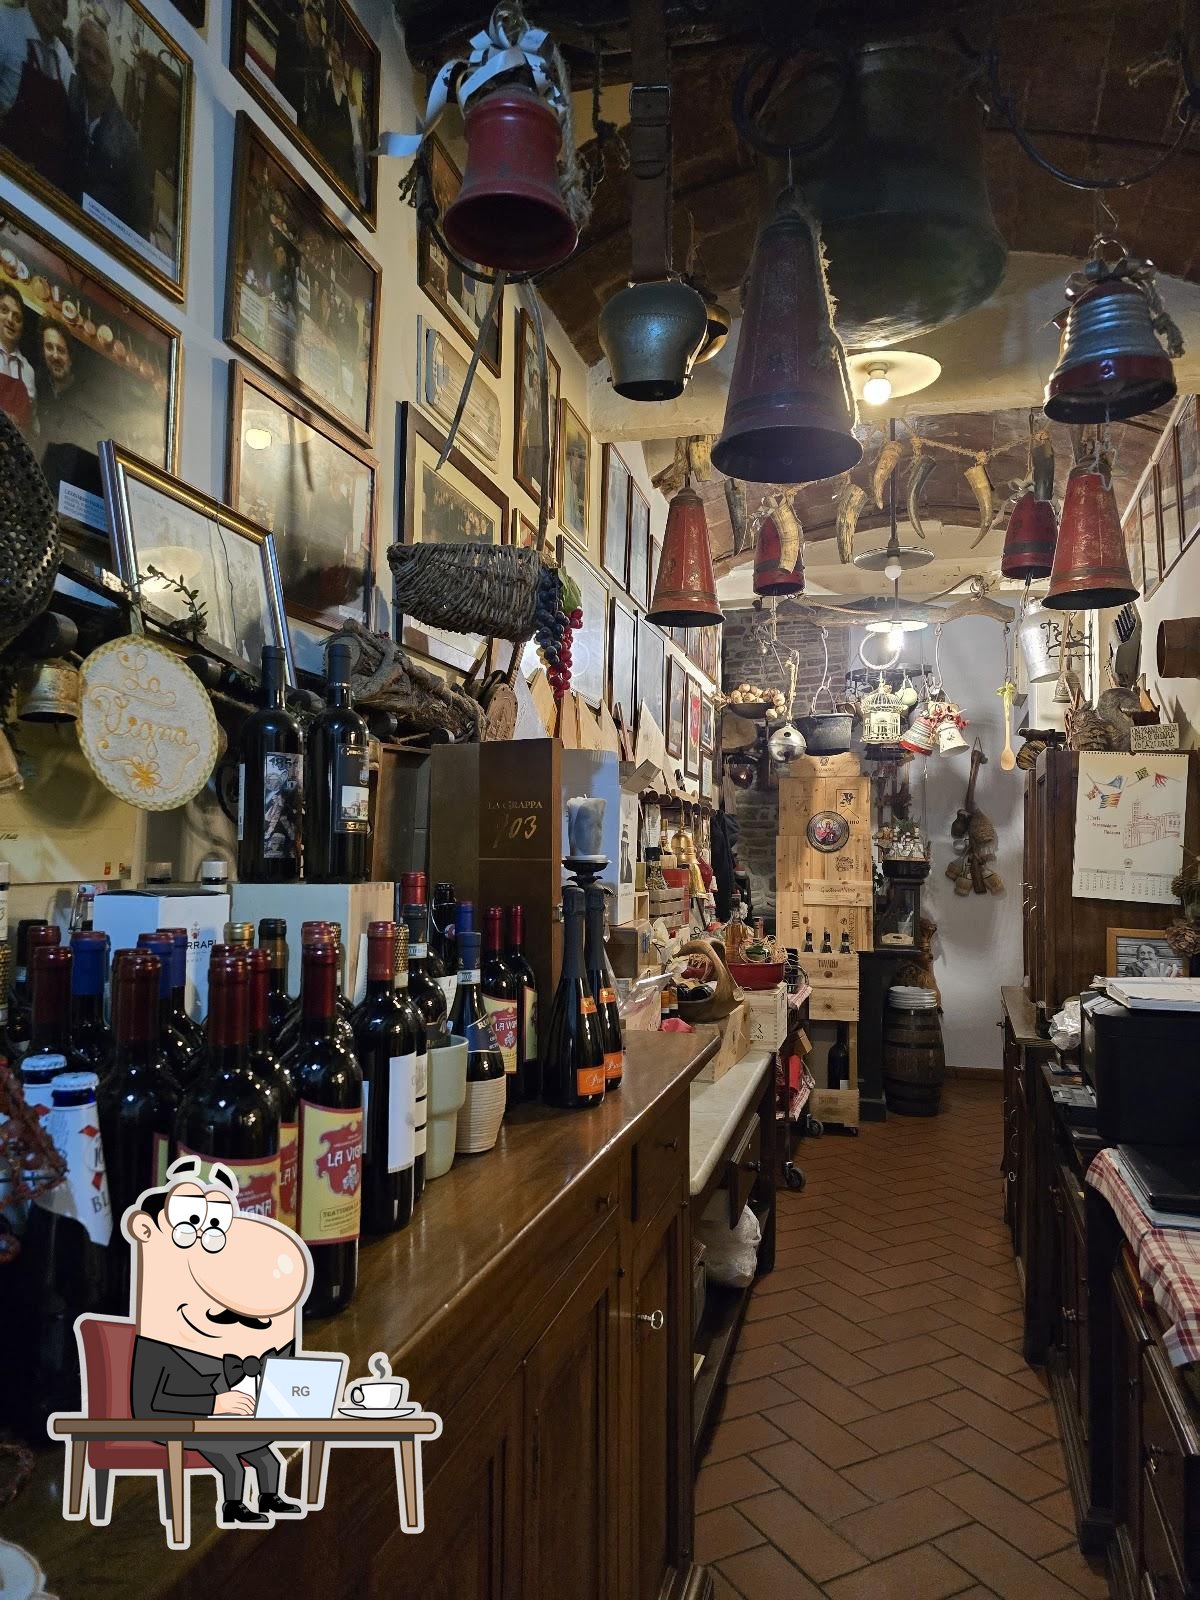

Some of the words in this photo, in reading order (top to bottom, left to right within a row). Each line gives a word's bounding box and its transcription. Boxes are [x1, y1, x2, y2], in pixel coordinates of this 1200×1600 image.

[91, 686, 197, 760] Vigna
[488, 801, 500, 809] LA
[502, 800, 543, 809] GRAPPA
[186, 939, 217, 949] RRARI
[327, 1150, 343, 1167] LA
[346, 1144, 362, 1162] VIG
